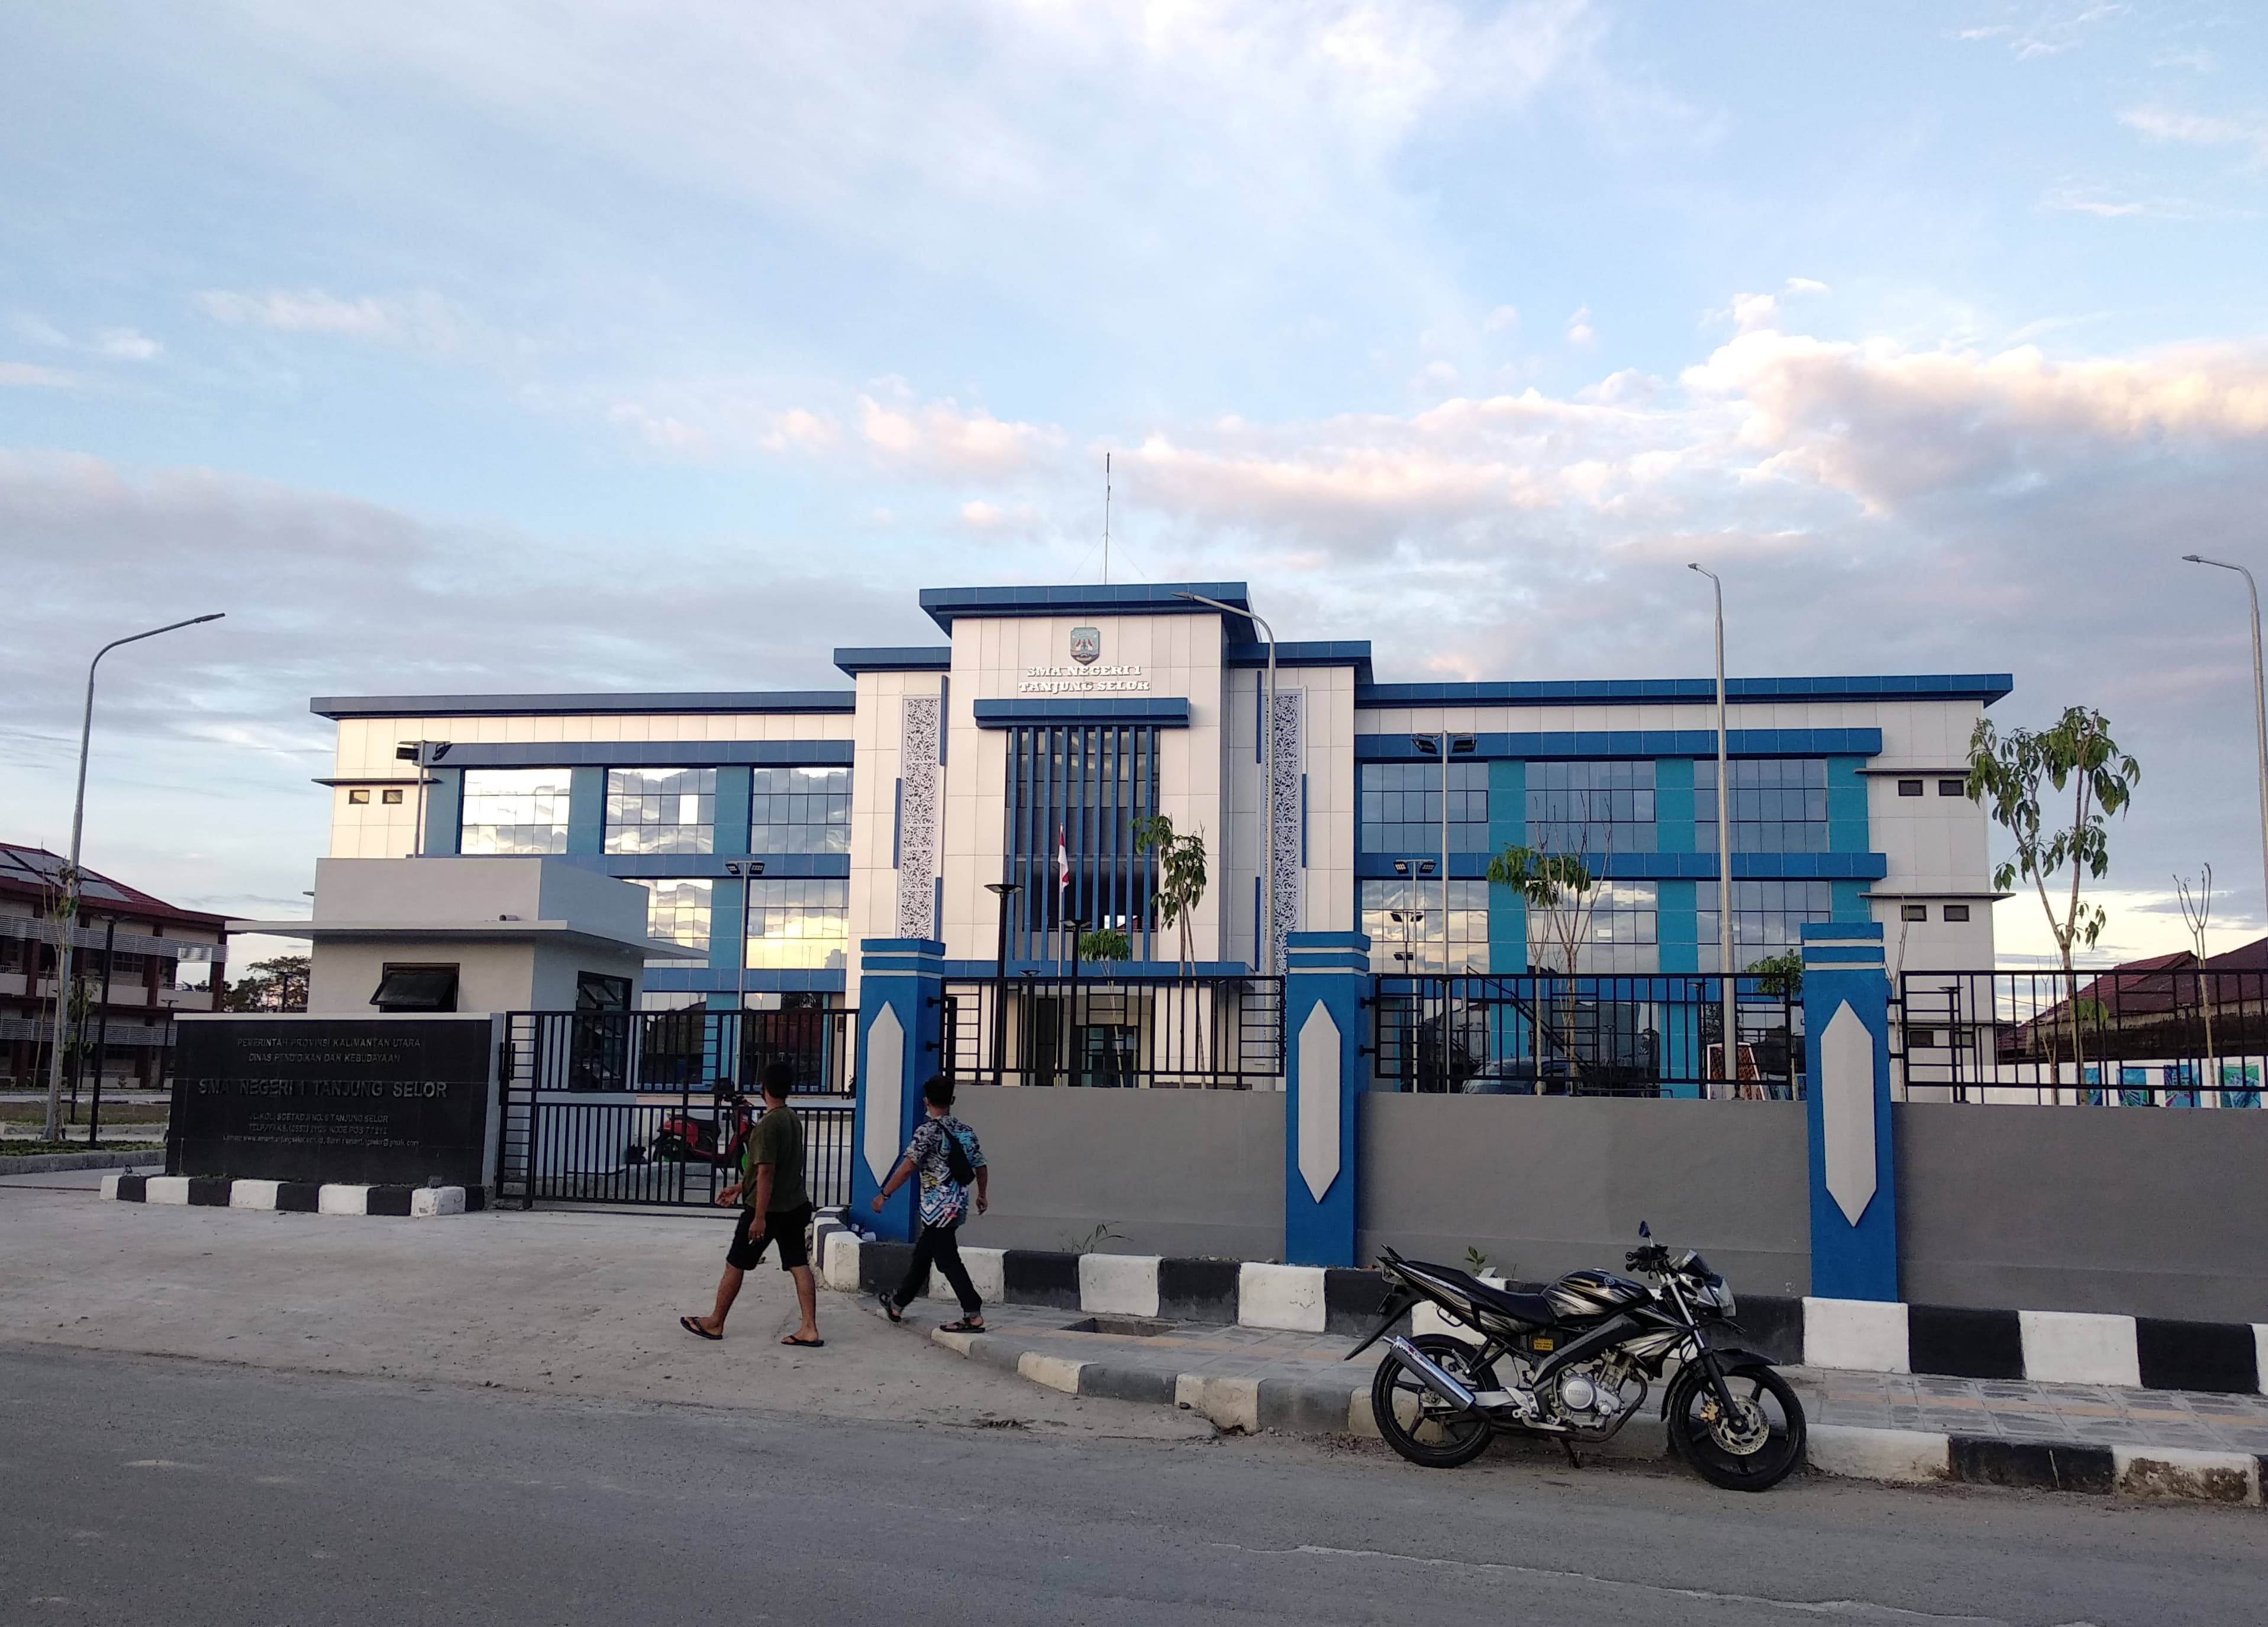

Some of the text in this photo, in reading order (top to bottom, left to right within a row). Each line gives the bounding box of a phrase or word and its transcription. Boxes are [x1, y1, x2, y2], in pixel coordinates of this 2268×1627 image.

[1027, 665, 1141, 676] SMA NEGERI 1
[1019, 681, 1150, 694] TANJUNG SELOR
[237, 1038, 289, 1047] PEMERINTAH
[333, 1038, 391, 1047] KALIMANTAN
[393, 1038, 421, 1048] UTARA
[249, 1053, 272, 1062] DINAS
[324, 1053, 341, 1062] DAN
[344, 1053, 401, 1063] KEBUDAYAAN
[240, 1079, 293, 1096] NEGERI
[298, 1080, 305, 1096] 1
[312, 1080, 383, 1097] TANJUNG
[392, 1081, 447, 1098] SELOR
[364, 1114, 388, 1123] SELOR
